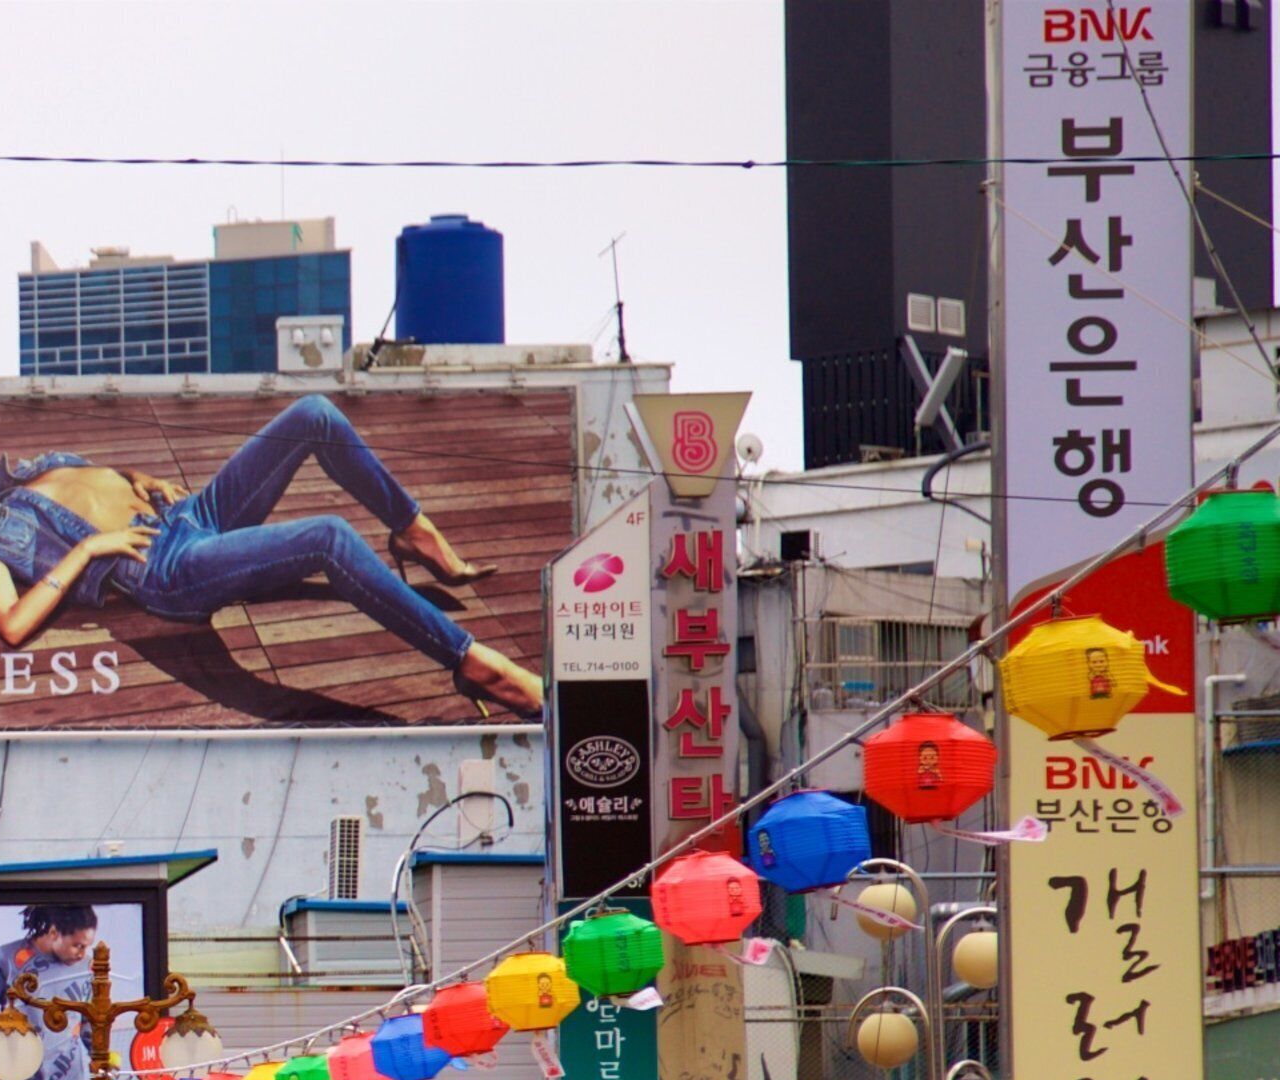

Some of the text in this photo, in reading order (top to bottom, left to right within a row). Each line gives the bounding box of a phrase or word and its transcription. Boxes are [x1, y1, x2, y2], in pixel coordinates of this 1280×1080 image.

[1042, 7, 1154, 42] BNK
[1023, 51, 1170, 88] 금융그룹
[1047, 116, 1137, 518] 부산은행
[625, 512, 646, 526] 4F
[556, 602, 643, 619] 스타화이트
[565, 622, 635, 641] 치과의원
[561, 660, 640, 673] TEL.714-0100
[578, 740, 632, 760] ASHLEY
[577, 795, 629, 814] 애슐리
